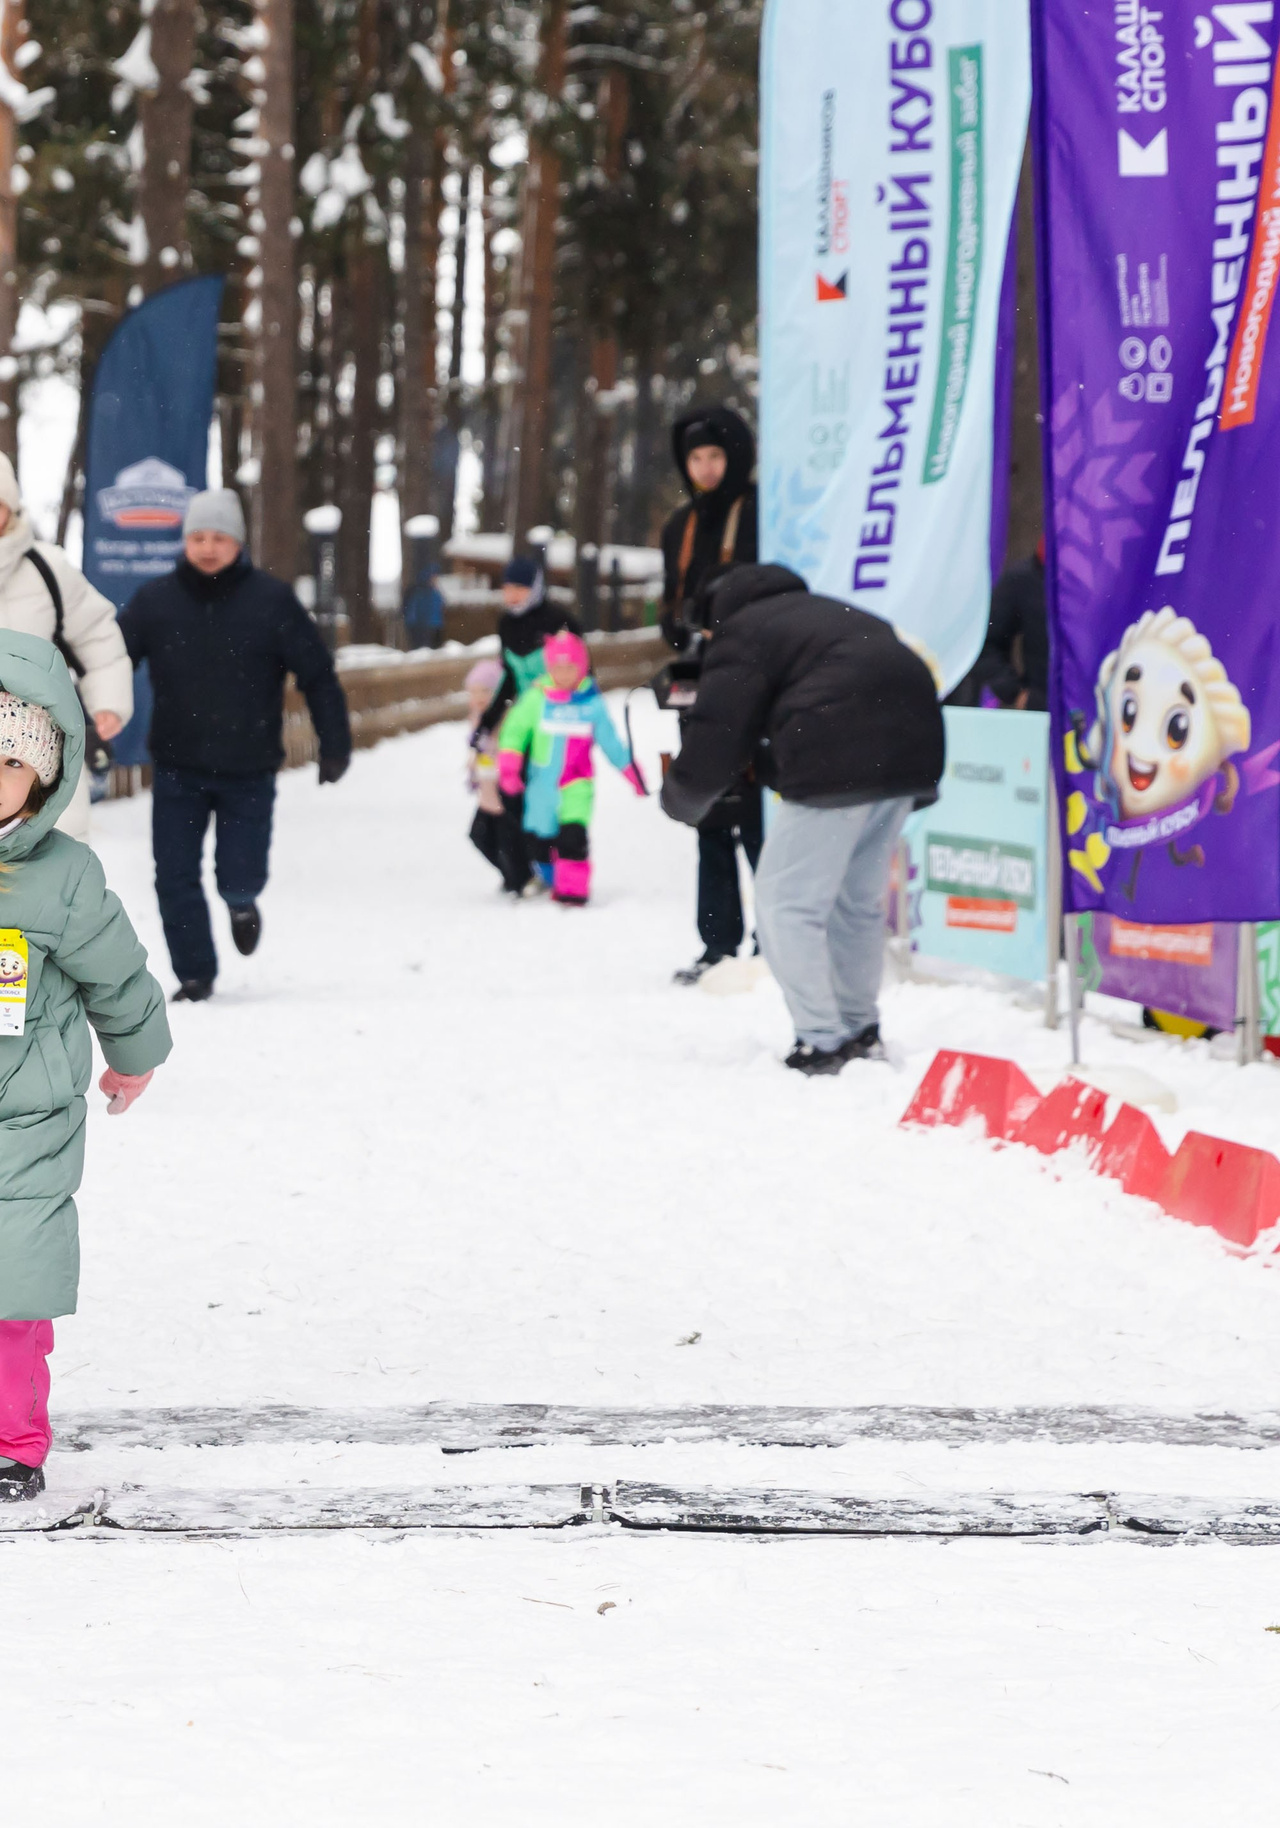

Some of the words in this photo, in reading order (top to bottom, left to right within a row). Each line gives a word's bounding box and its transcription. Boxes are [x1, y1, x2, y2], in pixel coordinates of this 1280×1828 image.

[954, 56, 978, 127] забег
[1140, 7, 1167, 113] СПОРТ
[815, 89, 836, 257] КАЛАШНИКОВ
[831, 180, 850, 255] СПОРТ
[954, 131, 978, 320] многодневный
[1155, 1, 1274, 577] ПЕЛЬМЕННЫЙ
[1228, 207, 1280, 414] Новогодний
[853, 173, 934, 591] ПЕЛЬМЕННЫЙ
